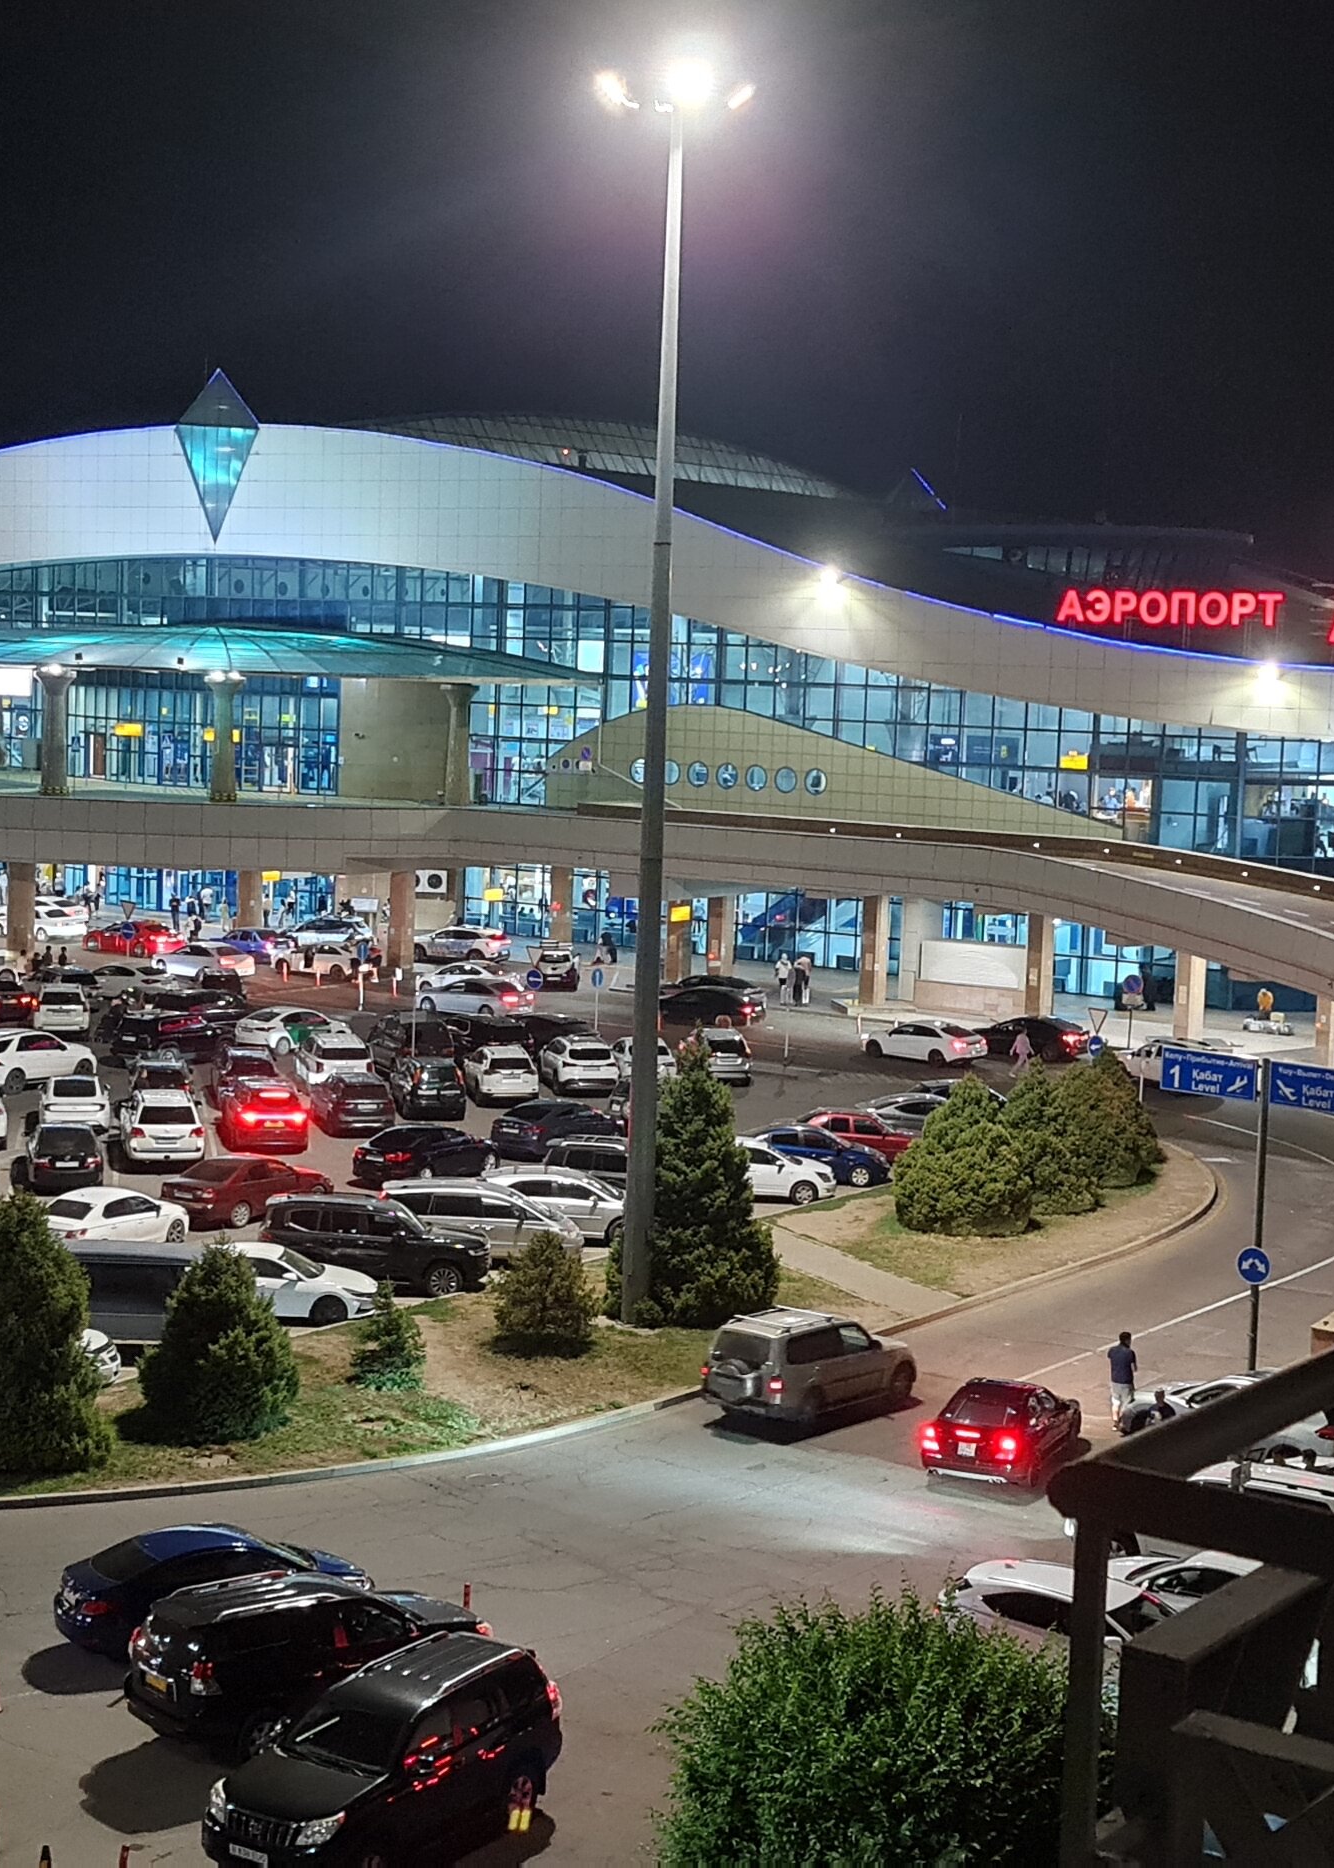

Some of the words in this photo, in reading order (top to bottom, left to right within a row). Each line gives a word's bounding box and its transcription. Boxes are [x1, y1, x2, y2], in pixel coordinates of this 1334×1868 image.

[1057, 588, 1283, 628] АЭРОПОРТ
[1169, 1064, 1180, 1088] 1
[1192, 1068, 1223, 1083] Қабат
[1191, 1080, 1220, 1094] Level
[1301, 1096, 1331, 1109] Level
